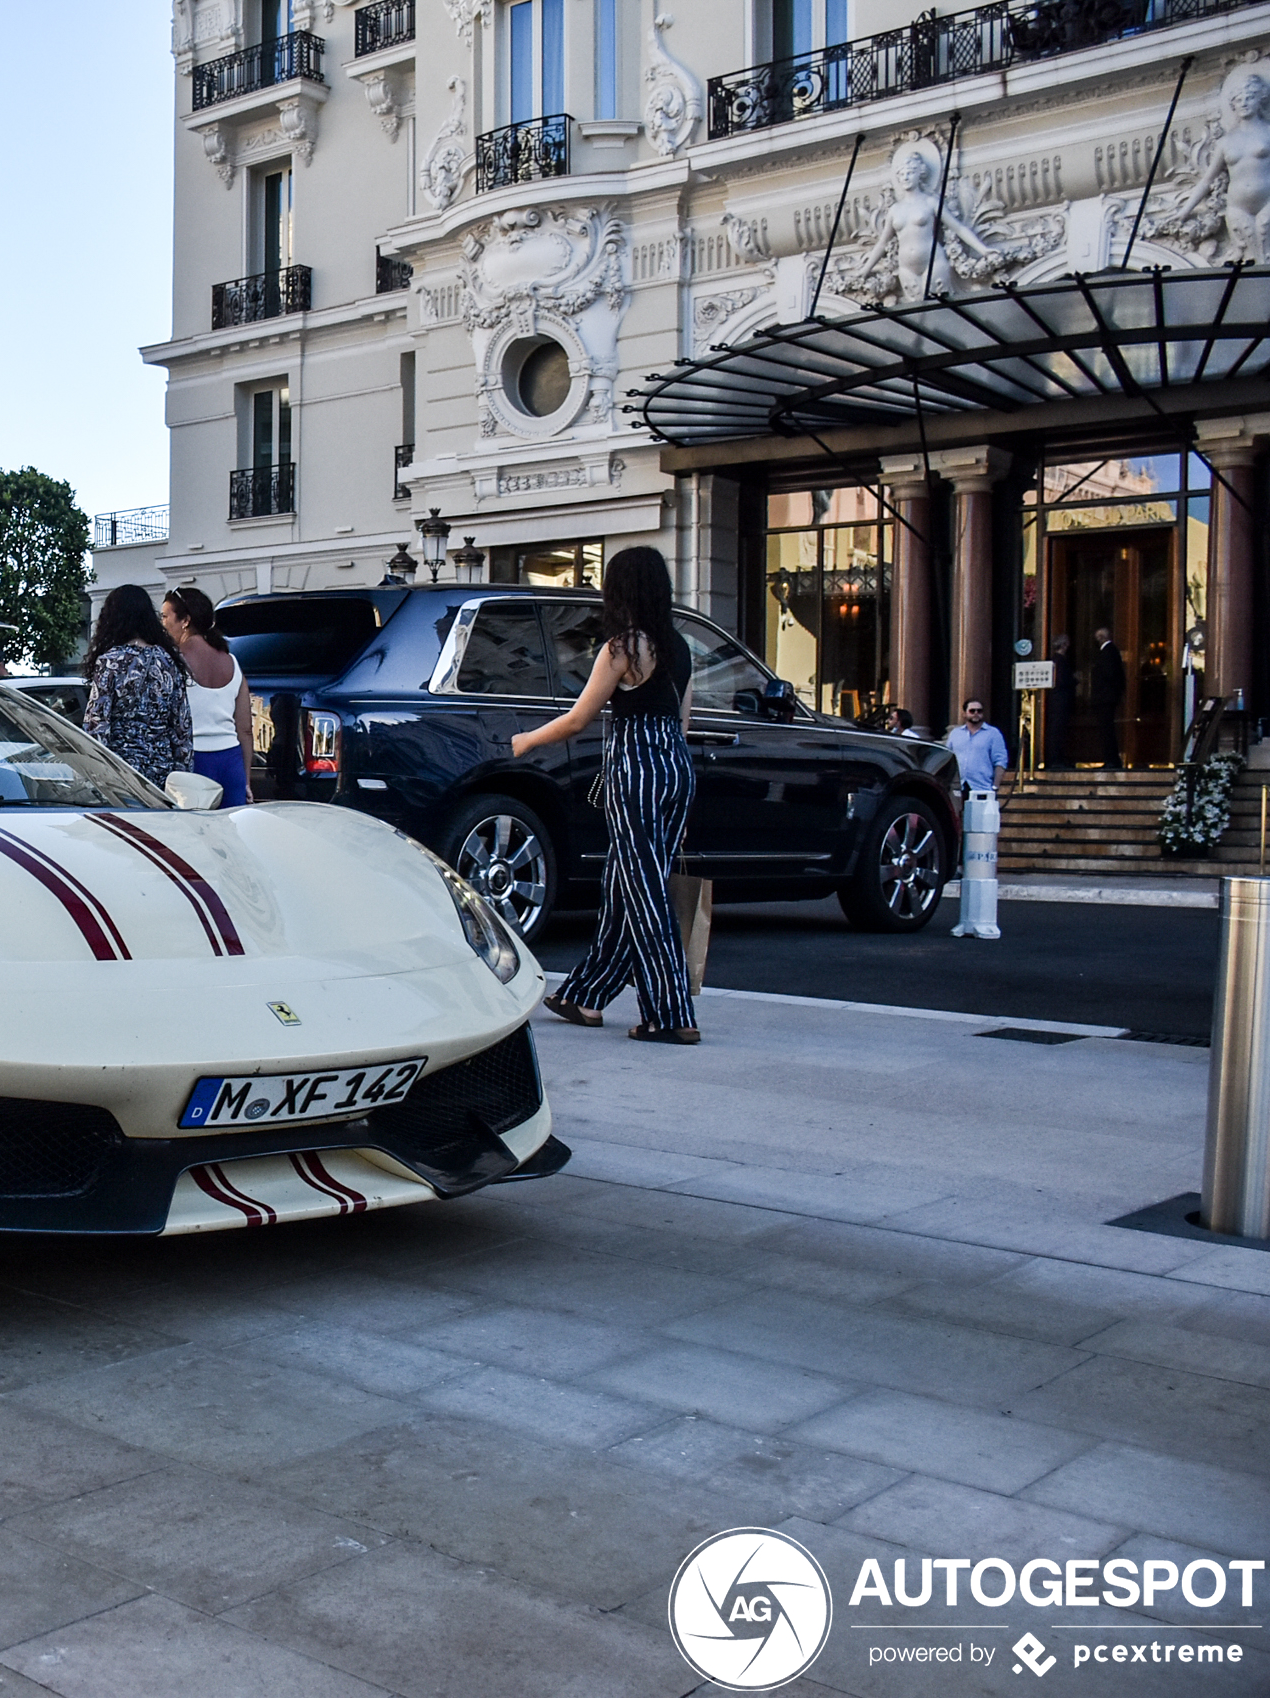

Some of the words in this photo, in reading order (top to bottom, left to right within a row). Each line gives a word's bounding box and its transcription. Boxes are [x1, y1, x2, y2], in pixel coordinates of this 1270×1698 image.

[191, 1107, 203, 1119] D
[210, 1082, 252, 1121] M
[270, 1075, 339, 1117] XF
[334, 1064, 419, 1110] 142
